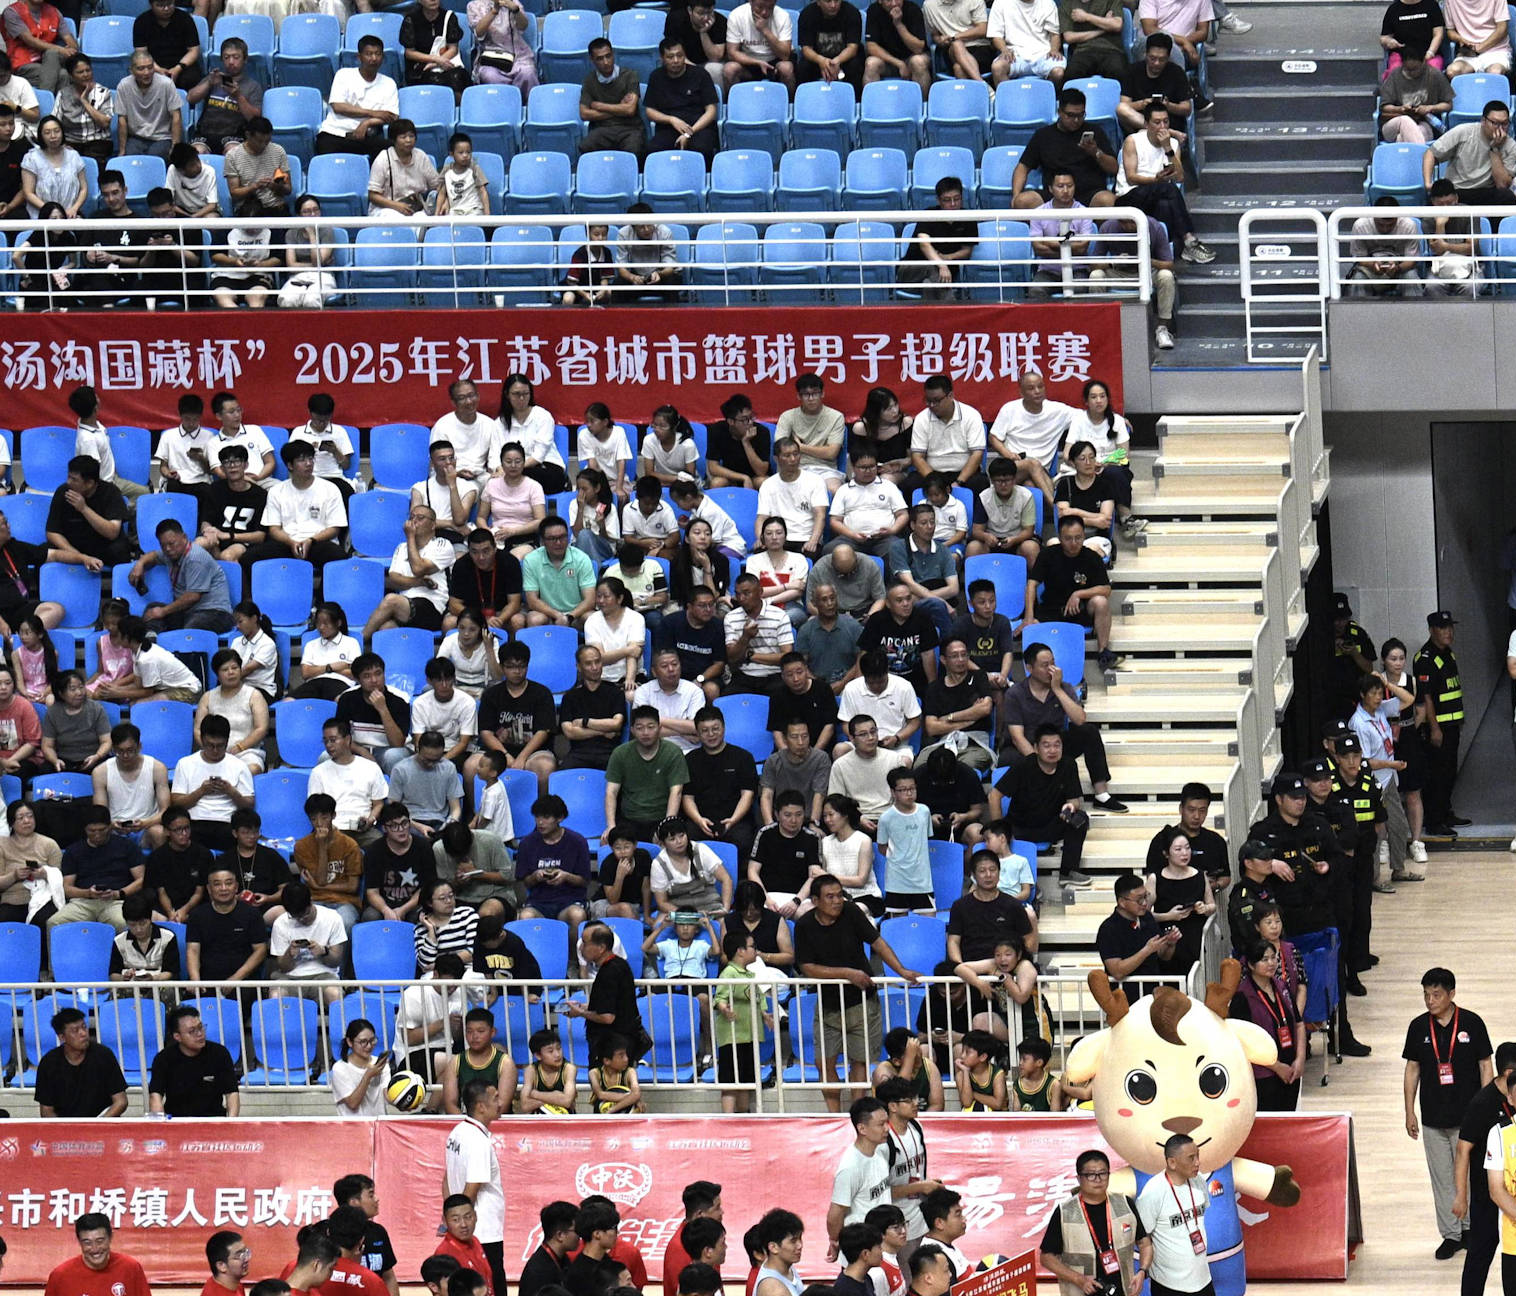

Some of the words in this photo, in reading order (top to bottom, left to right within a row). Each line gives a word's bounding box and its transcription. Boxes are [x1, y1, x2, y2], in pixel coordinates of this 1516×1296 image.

[295, 334, 1093, 386] 2025年江苏省城市篮球男子超级联赛
[591, 1166, 637, 1194] 中沃
[0, 1186, 333, 1229] 市和桥镇人民政府
